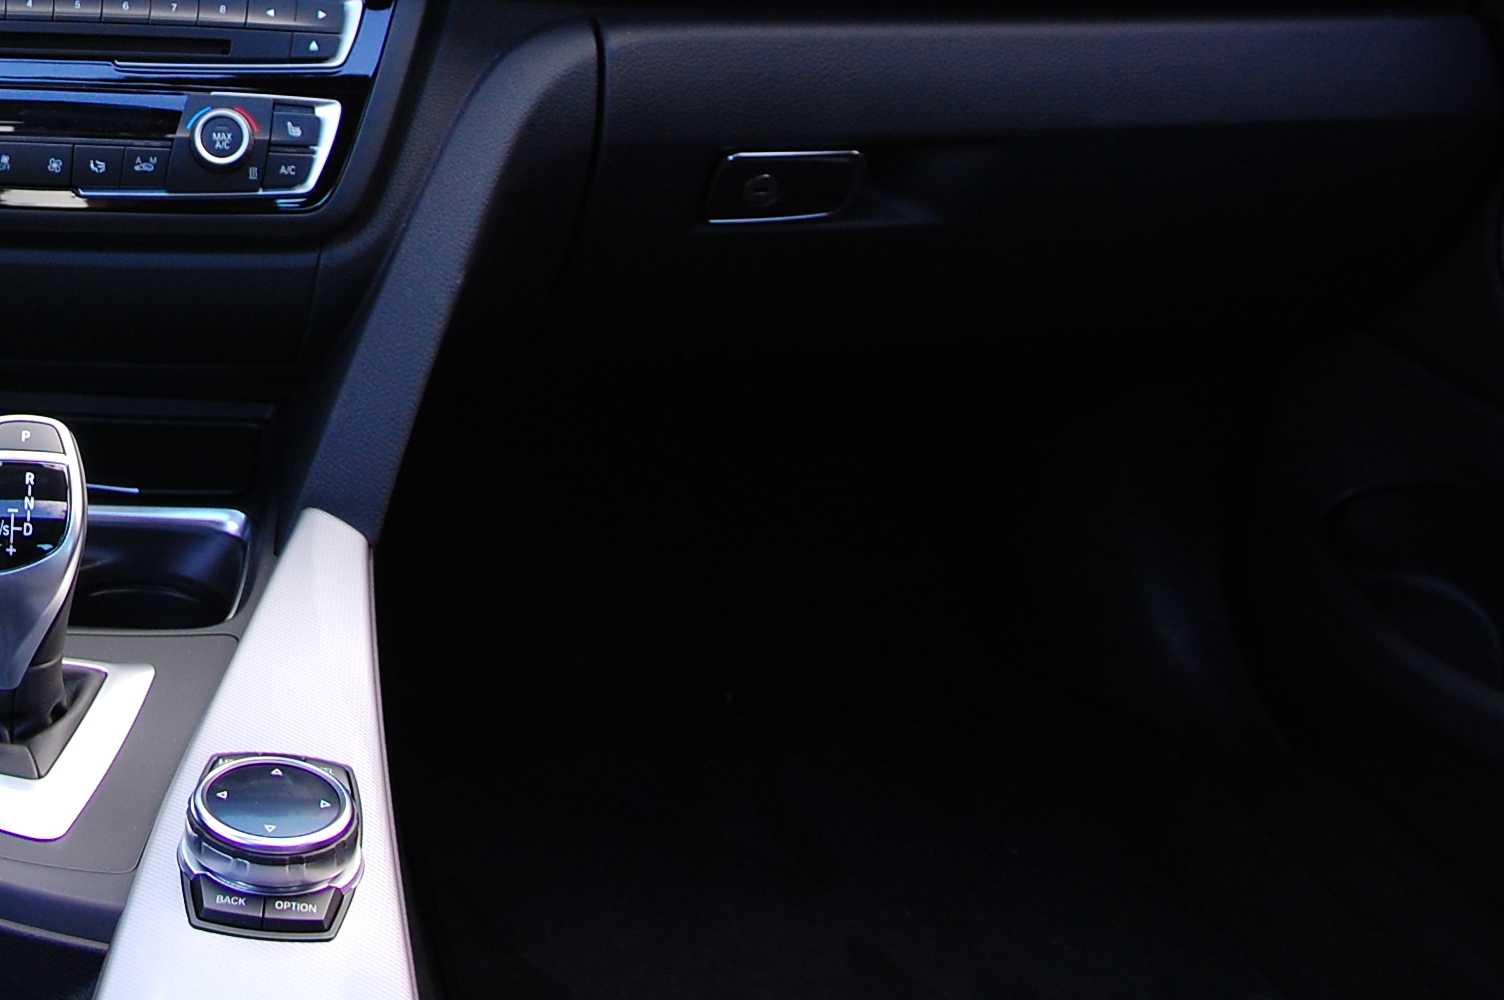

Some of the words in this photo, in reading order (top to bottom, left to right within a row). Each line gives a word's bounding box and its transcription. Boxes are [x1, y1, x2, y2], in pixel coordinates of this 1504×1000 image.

[26, 0, 33, 8] 4
[75, 0, 81, 9] 5
[122, 1, 129, 11] 6
[171, 3, 178, 12] 7
[219, 4, 226, 14] 8
[212, 131, 232, 141] MAX
[215, 139, 230, 150] A/C
[280, 164, 296, 176] A/C
[21, 430, 31, 442] P
[25, 472, 35, 485] R
[24, 496, 34, 510] N
[23, 522, 33, 536] D
[215, 894, 246, 907] BACK
[274, 900, 317, 914] OPTION
